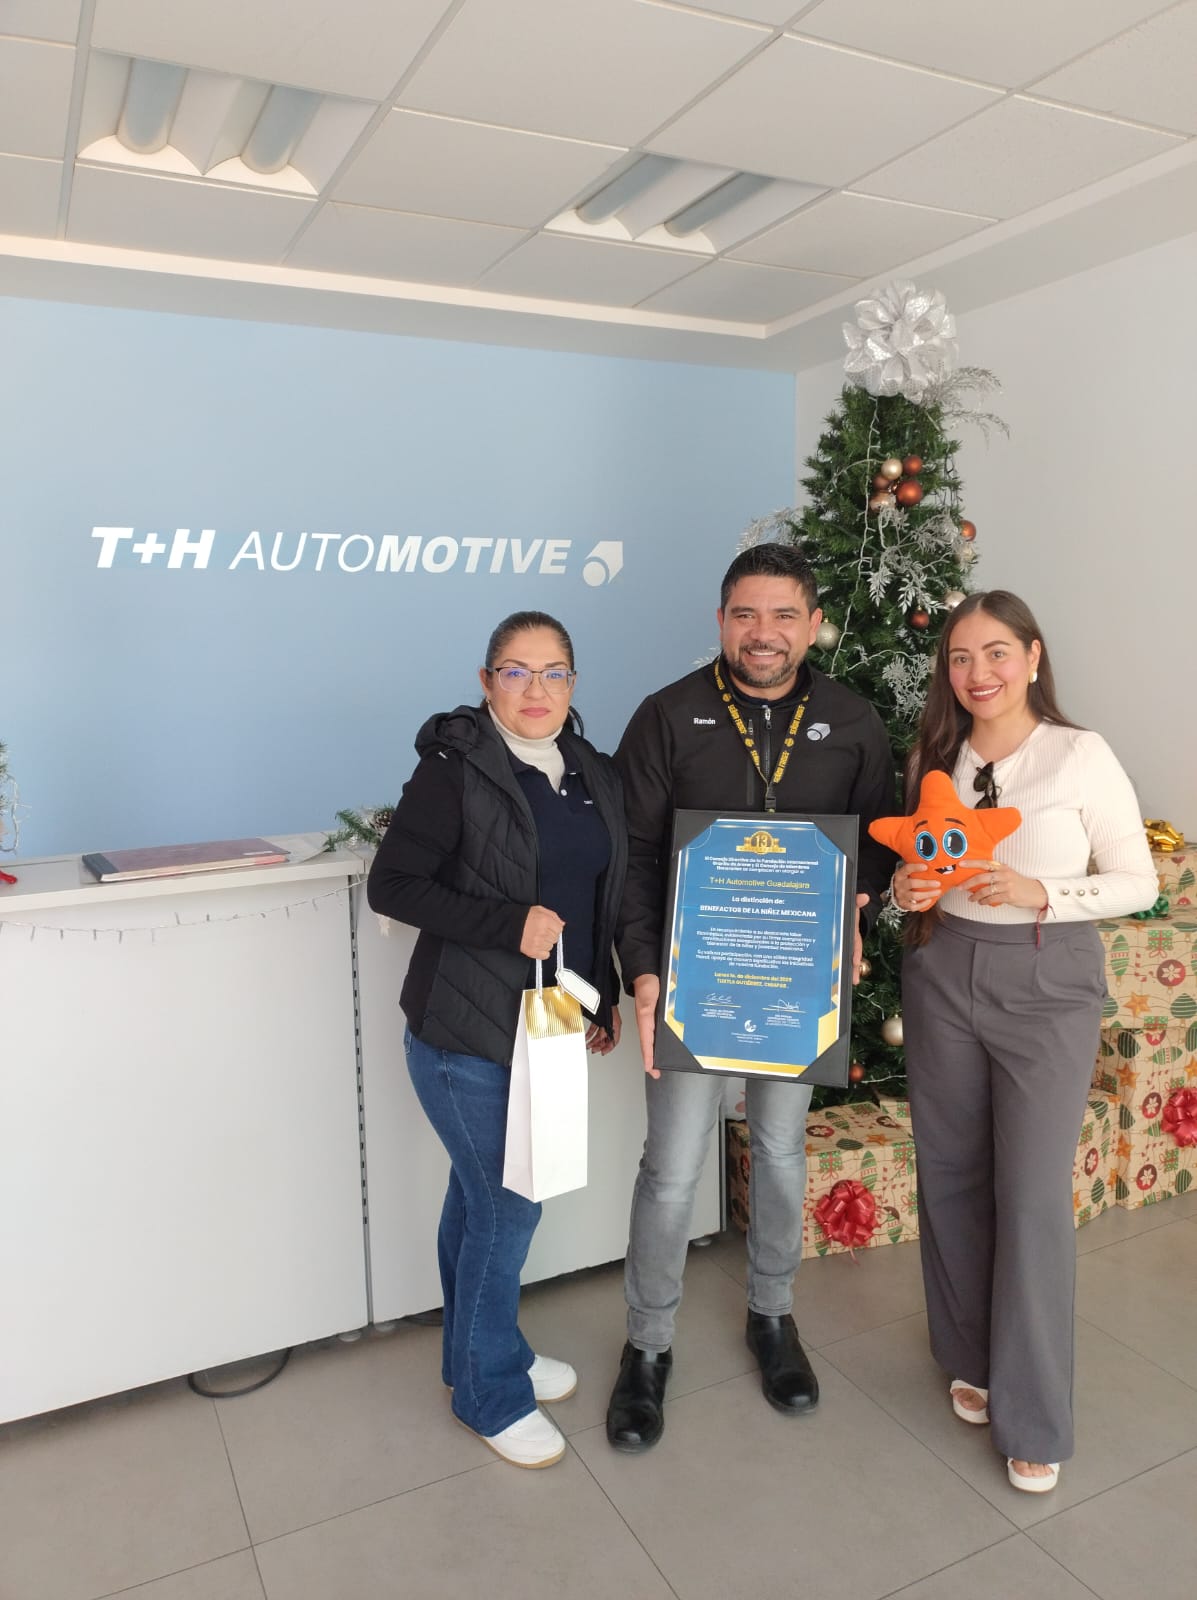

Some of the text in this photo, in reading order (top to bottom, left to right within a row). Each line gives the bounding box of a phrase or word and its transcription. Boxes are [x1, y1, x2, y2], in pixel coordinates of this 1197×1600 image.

[91, 526, 572, 575] T+H AUTOMOTIVE
[693, 717, 716, 725] Ramón
[726, 878, 765, 887] Automotive
[766, 880, 810, 890] Guadalajara
[781, 909, 817, 918] MEXICANA
